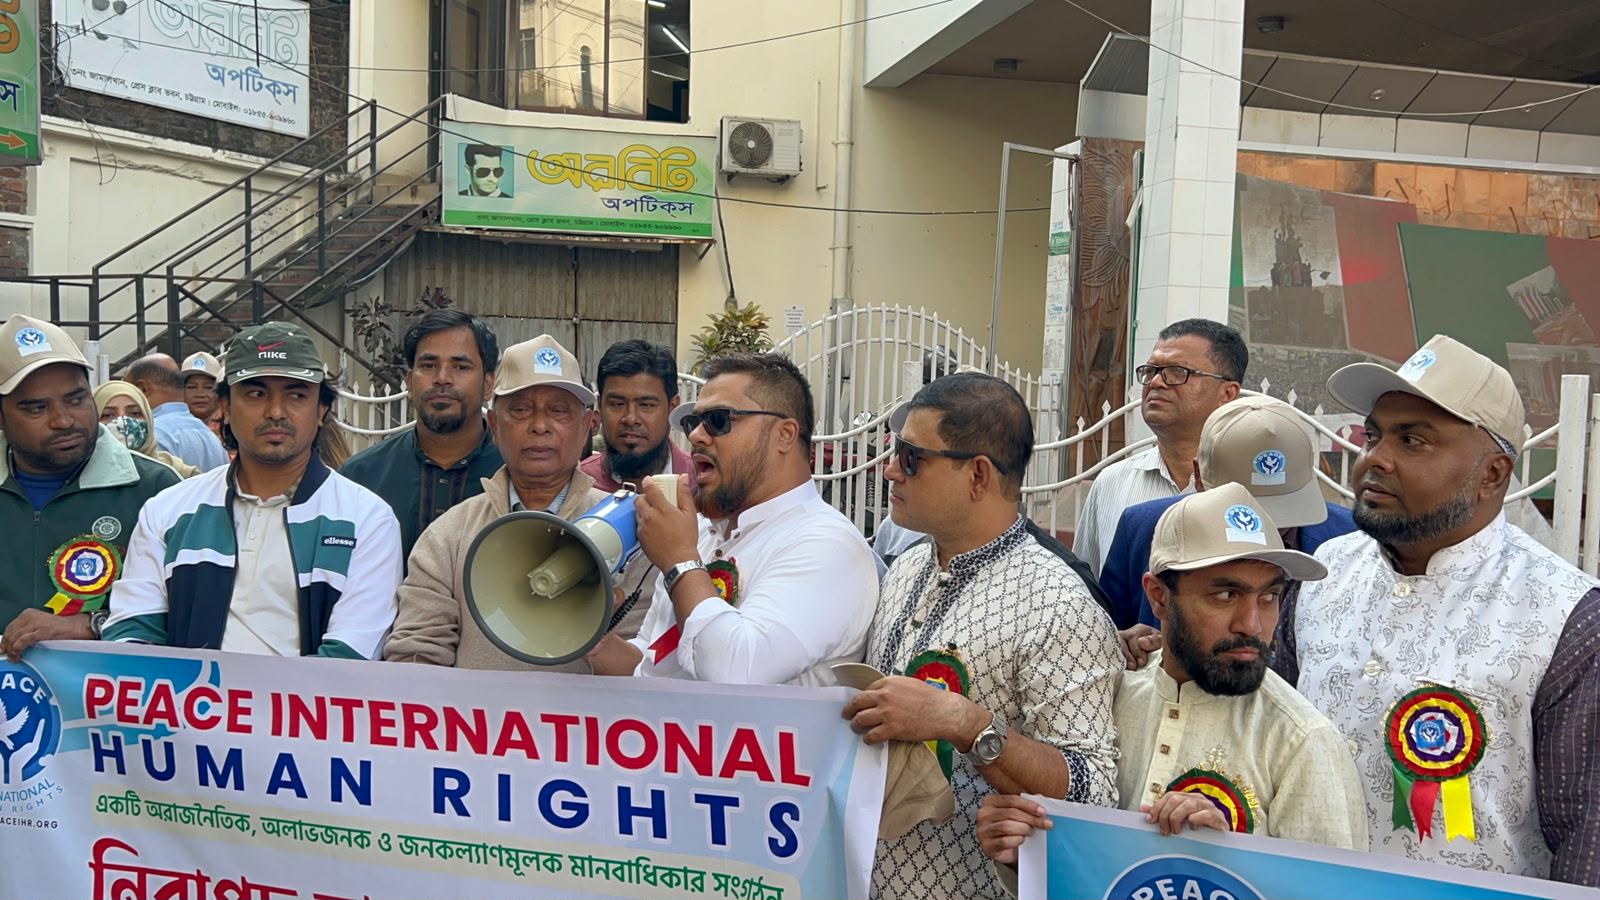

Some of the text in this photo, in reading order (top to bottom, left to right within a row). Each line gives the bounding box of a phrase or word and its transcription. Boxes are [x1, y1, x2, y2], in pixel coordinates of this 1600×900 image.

[600, 195, 694, 218] অপটিক্স
[258, 351, 287, 359] NIKE
[324, 537, 354, 546] ellesse
[0, 673, 47, 704] ACE
[85, 677, 811, 787] PEACE INTERNATIONAL
[91, 732, 800, 858] HUMAN RIGHTS
[0, 816, 58, 829] ACEIHR.ORG
[96, 789, 141, 817] একটি
[144, 800, 257, 838] অরাজনৈতিক,
[260, 816, 371, 850] অলাভজনক
[378, 832, 392, 852] ও
[397, 834, 563, 876] জনকল্যাণমূলক
[568, 855, 706, 893] মানবাধিকার
[1131, 878, 1235, 900] PEAC
